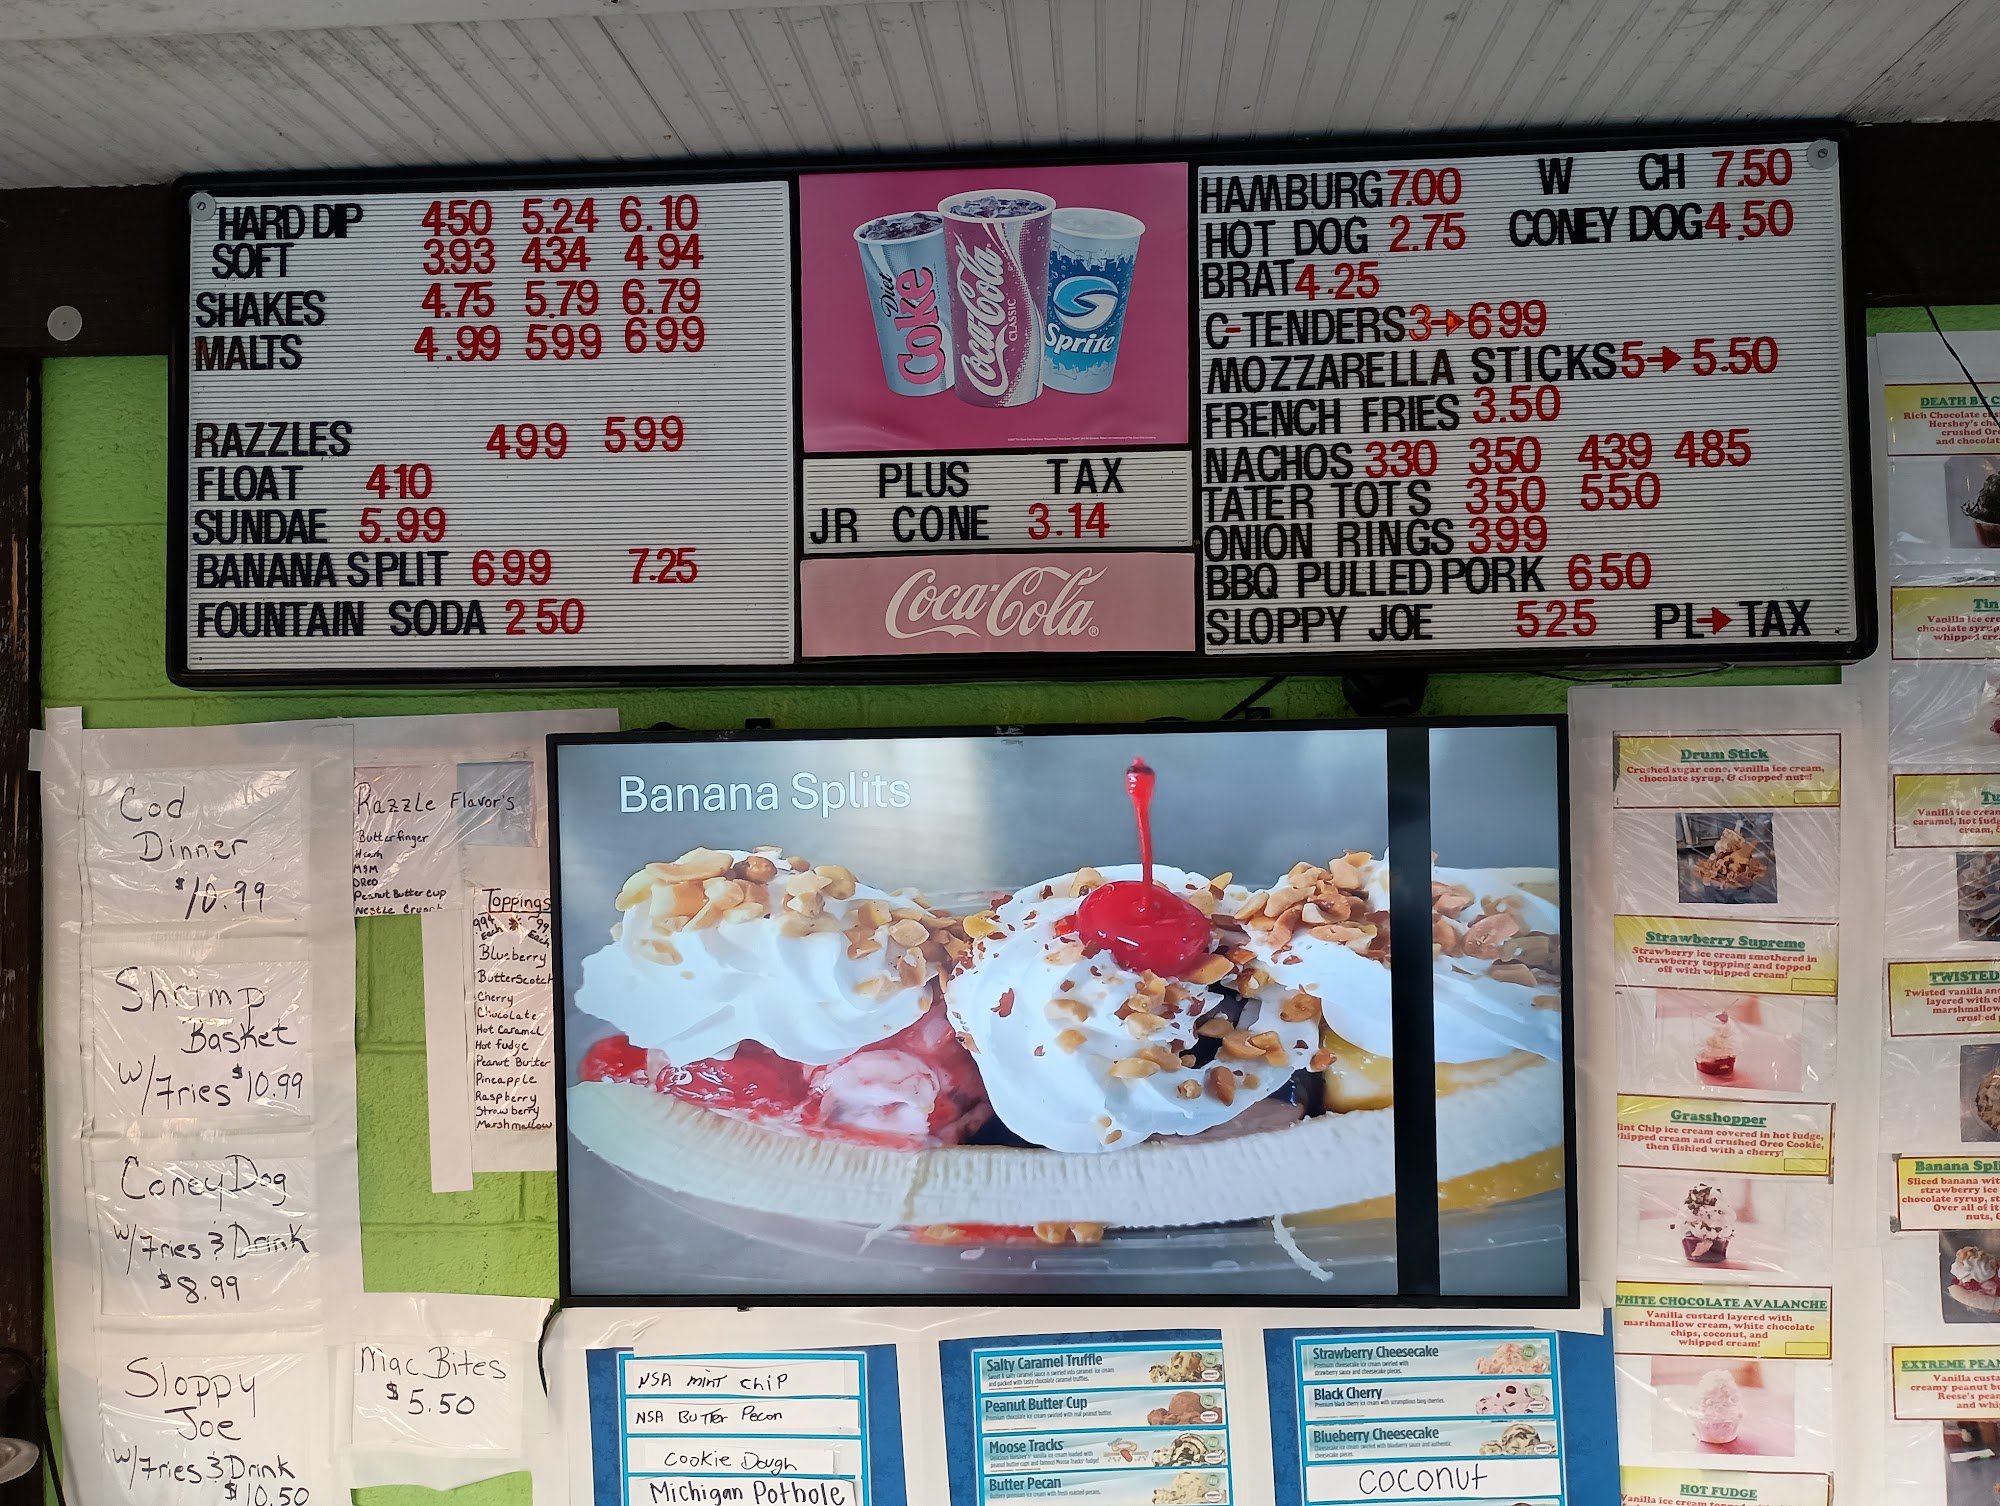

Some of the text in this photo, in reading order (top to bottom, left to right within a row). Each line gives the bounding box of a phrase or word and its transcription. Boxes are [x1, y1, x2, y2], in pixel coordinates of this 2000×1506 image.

[1200, 148, 1792, 213] HAMBURG 7.00 7.50
[219, 194, 698, 240] HARD DIP 450 5.24 6.10
[1206, 200, 1794, 258] HOT DOG 2.75 CONEY DOG 4.50
[212, 237, 590, 278] SOFT 3.93 434
[1201, 259, 1379, 299] BRAT 4.25
[196, 278, 701, 327] SHAKES 4.75 5.79 6.79
[894, 266, 946, 385] Coke
[1008, 299, 1017, 341] CLASSIC
[1206, 305, 1405, 349] C-TENDERS
[195, 325, 500, 371] MALTS 4.99
[1045, 322, 1114, 354] Sprite
[1207, 336, 1778, 394] MOZZARELLA STICKS 5.50
[1204, 384, 1561, 439] FRENCH FRIES 3.50
[1920, 397, 1966, 406] DEATH
[196, 421, 352, 458] RAZZLES
[1929, 420, 1978, 430] Hershey's
[879, 458, 1124, 498] PLUS TAX
[1205, 443, 1353, 483] NACHOS
[198, 463, 432, 501] FLOAT 410
[1202, 480, 1431, 522] TATER TOTS
[193, 507, 446, 545] SUNDAE 5.99
[810, 503, 1110, 544] JR CONE 3.14
[1204, 519, 1454, 562] ONION RINGS
[197, 548, 697, 588] BANANA SPLIT 7.25
[1207, 556, 1546, 600] BBQ PULLED PORK
[197, 599, 487, 637] FOUNTAIN SODA
[1206, 599, 1597, 644] SLOPPY JOE 525
[1681, 748, 1769, 760] Drum Stick
[1734, 765, 1769, 773] vanilla
[120, 787, 185, 822] Cod
[620, 771, 911, 818] Banana Splits
[133, 831, 247, 861] Dinner
[175, 876, 265, 919] $10.99
[1646, 931, 1805, 949] Strawberry Supreme
[1714, 952, 1804, 962] cream smothered
[1930, 971, 1999, 982] TWISTED
[116, 967, 266, 1029] Shrimp
[1927, 997, 1963, 1006] layered
[181, 1017, 296, 1053] Basket
[232, 1064, 302, 1102] $10.99
[1638, 1124, 1756, 1138] Chip cream covered
[1671, 1110, 1767, 1125] Grasshopper
[1915, 1161, 1969, 1171] Banana
[122, 1155, 286, 1211] Coney Dog
[158, 1269, 240, 1303] $8.99
[1659, 1296, 1827, 1309] CHOCOLATE AVALANCHE
[1624, 1320, 1694, 1328] marshmallow
[1767, 1323, 1815, 1331] chocolate
[1686, 1312, 1724, 1320] custard
[1728, 1313, 1765, 1322] layered
[1671, 1329, 1746, 1339] chips, coconut,
[1679, 1339, 1760, 1348] whipped cream!
[361, 1346, 506, 1378] Mac Bites
[987, 1352, 1102, 1373] Salty Caramel Truffle
[1313, 1345, 1438, 1362] Strawberry Cheesecake
[1902, 1360, 1965, 1369] EXTREME
[125, 1357, 255, 1417] Sloppy
[387, 1381, 474, 1414] $5.50
[1314, 1386, 1382, 1400] Black Cherry
[1911, 1384, 1988, 1392] creamy peanut
[1938, 1392, 1975, 1400] Reese's
[986, 1396, 1087, 1412] Peanut Butter Cup
[165, 1407, 241, 1440] Joe
[1314, 1427, 1439, 1445] Blueberry Cheesecake
[989, 1438, 1063, 1453] Moose Tracks
[224, 1455, 295, 1479] Drink
[664, 1451, 797, 1475] Cookie Dough
[650, 1480, 845, 1505] Michigan Pothole
[989, 1477, 1061, 1491] Butter Pecan
[1680, 1484, 1757, 1498] HOT FUDGE
